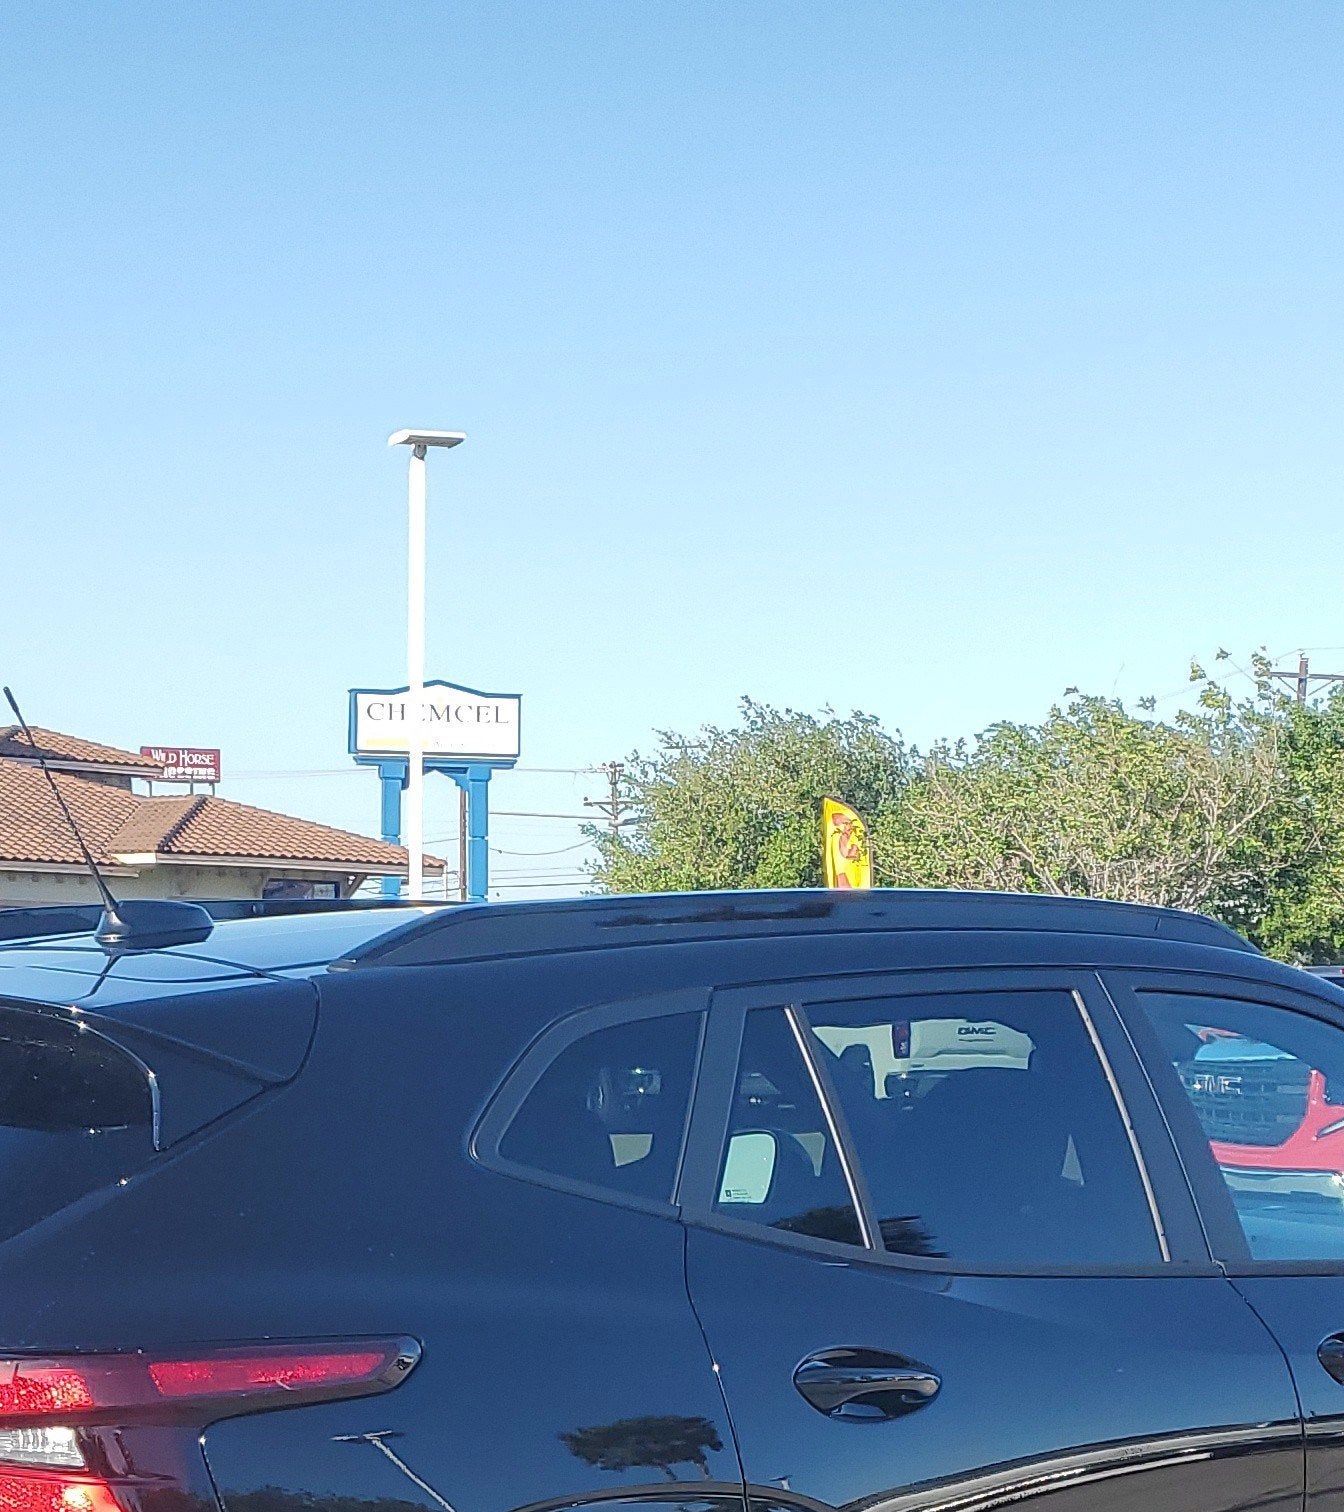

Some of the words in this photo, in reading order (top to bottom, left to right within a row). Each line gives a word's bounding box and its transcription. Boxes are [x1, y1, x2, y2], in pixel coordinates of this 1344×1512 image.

[366, 702, 509, 724] CHMCEL
[178, 750, 215, 766] HORSE
[957, 1027, 997, 1035] GMC
